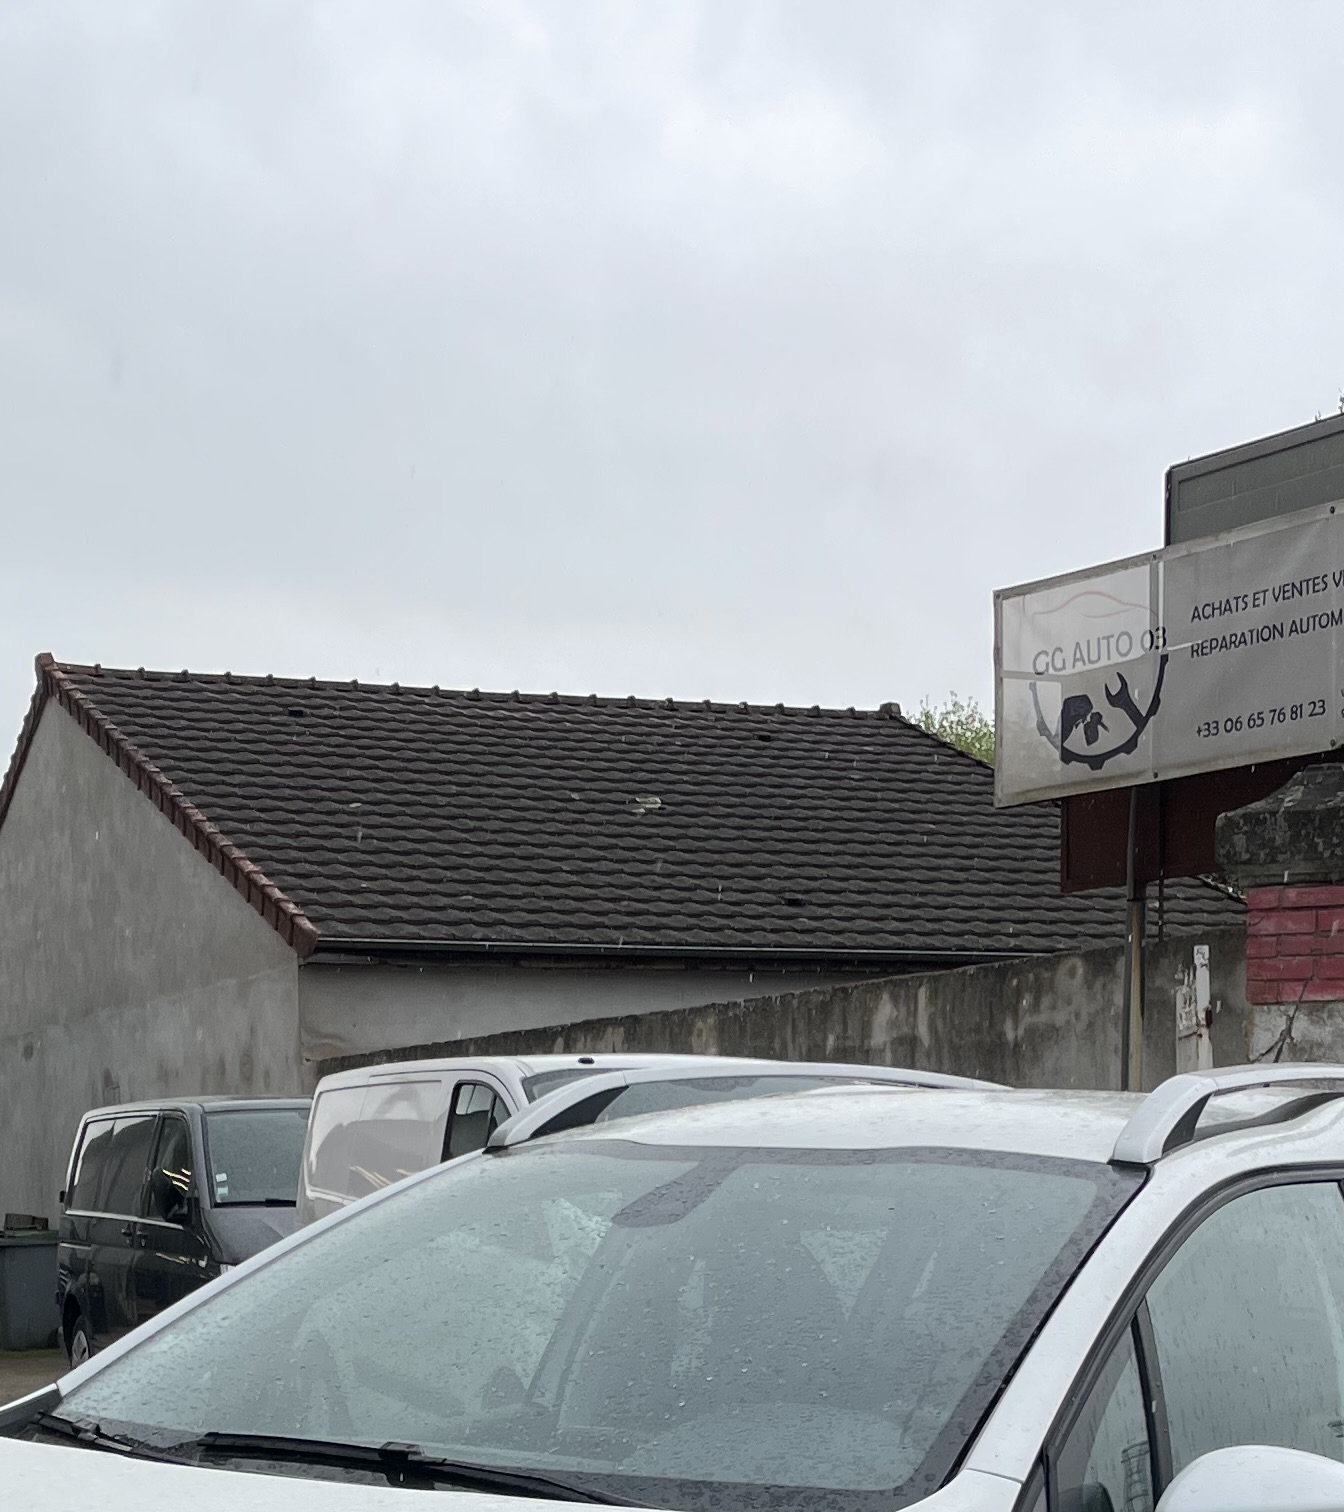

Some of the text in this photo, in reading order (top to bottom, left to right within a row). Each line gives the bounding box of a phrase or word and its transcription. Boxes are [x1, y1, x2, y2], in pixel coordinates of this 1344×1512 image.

[1190, 594, 1248, 623] ACHATS
[1252, 588, 1269, 608] ET
[1272, 574, 1328, 602] VENTES
[1032, 626, 1167, 675] GG AUTO 03
[1190, 622, 1284, 659] REPARATION
[1196, 699, 1326, 738] +33 06 65 76 81 23
